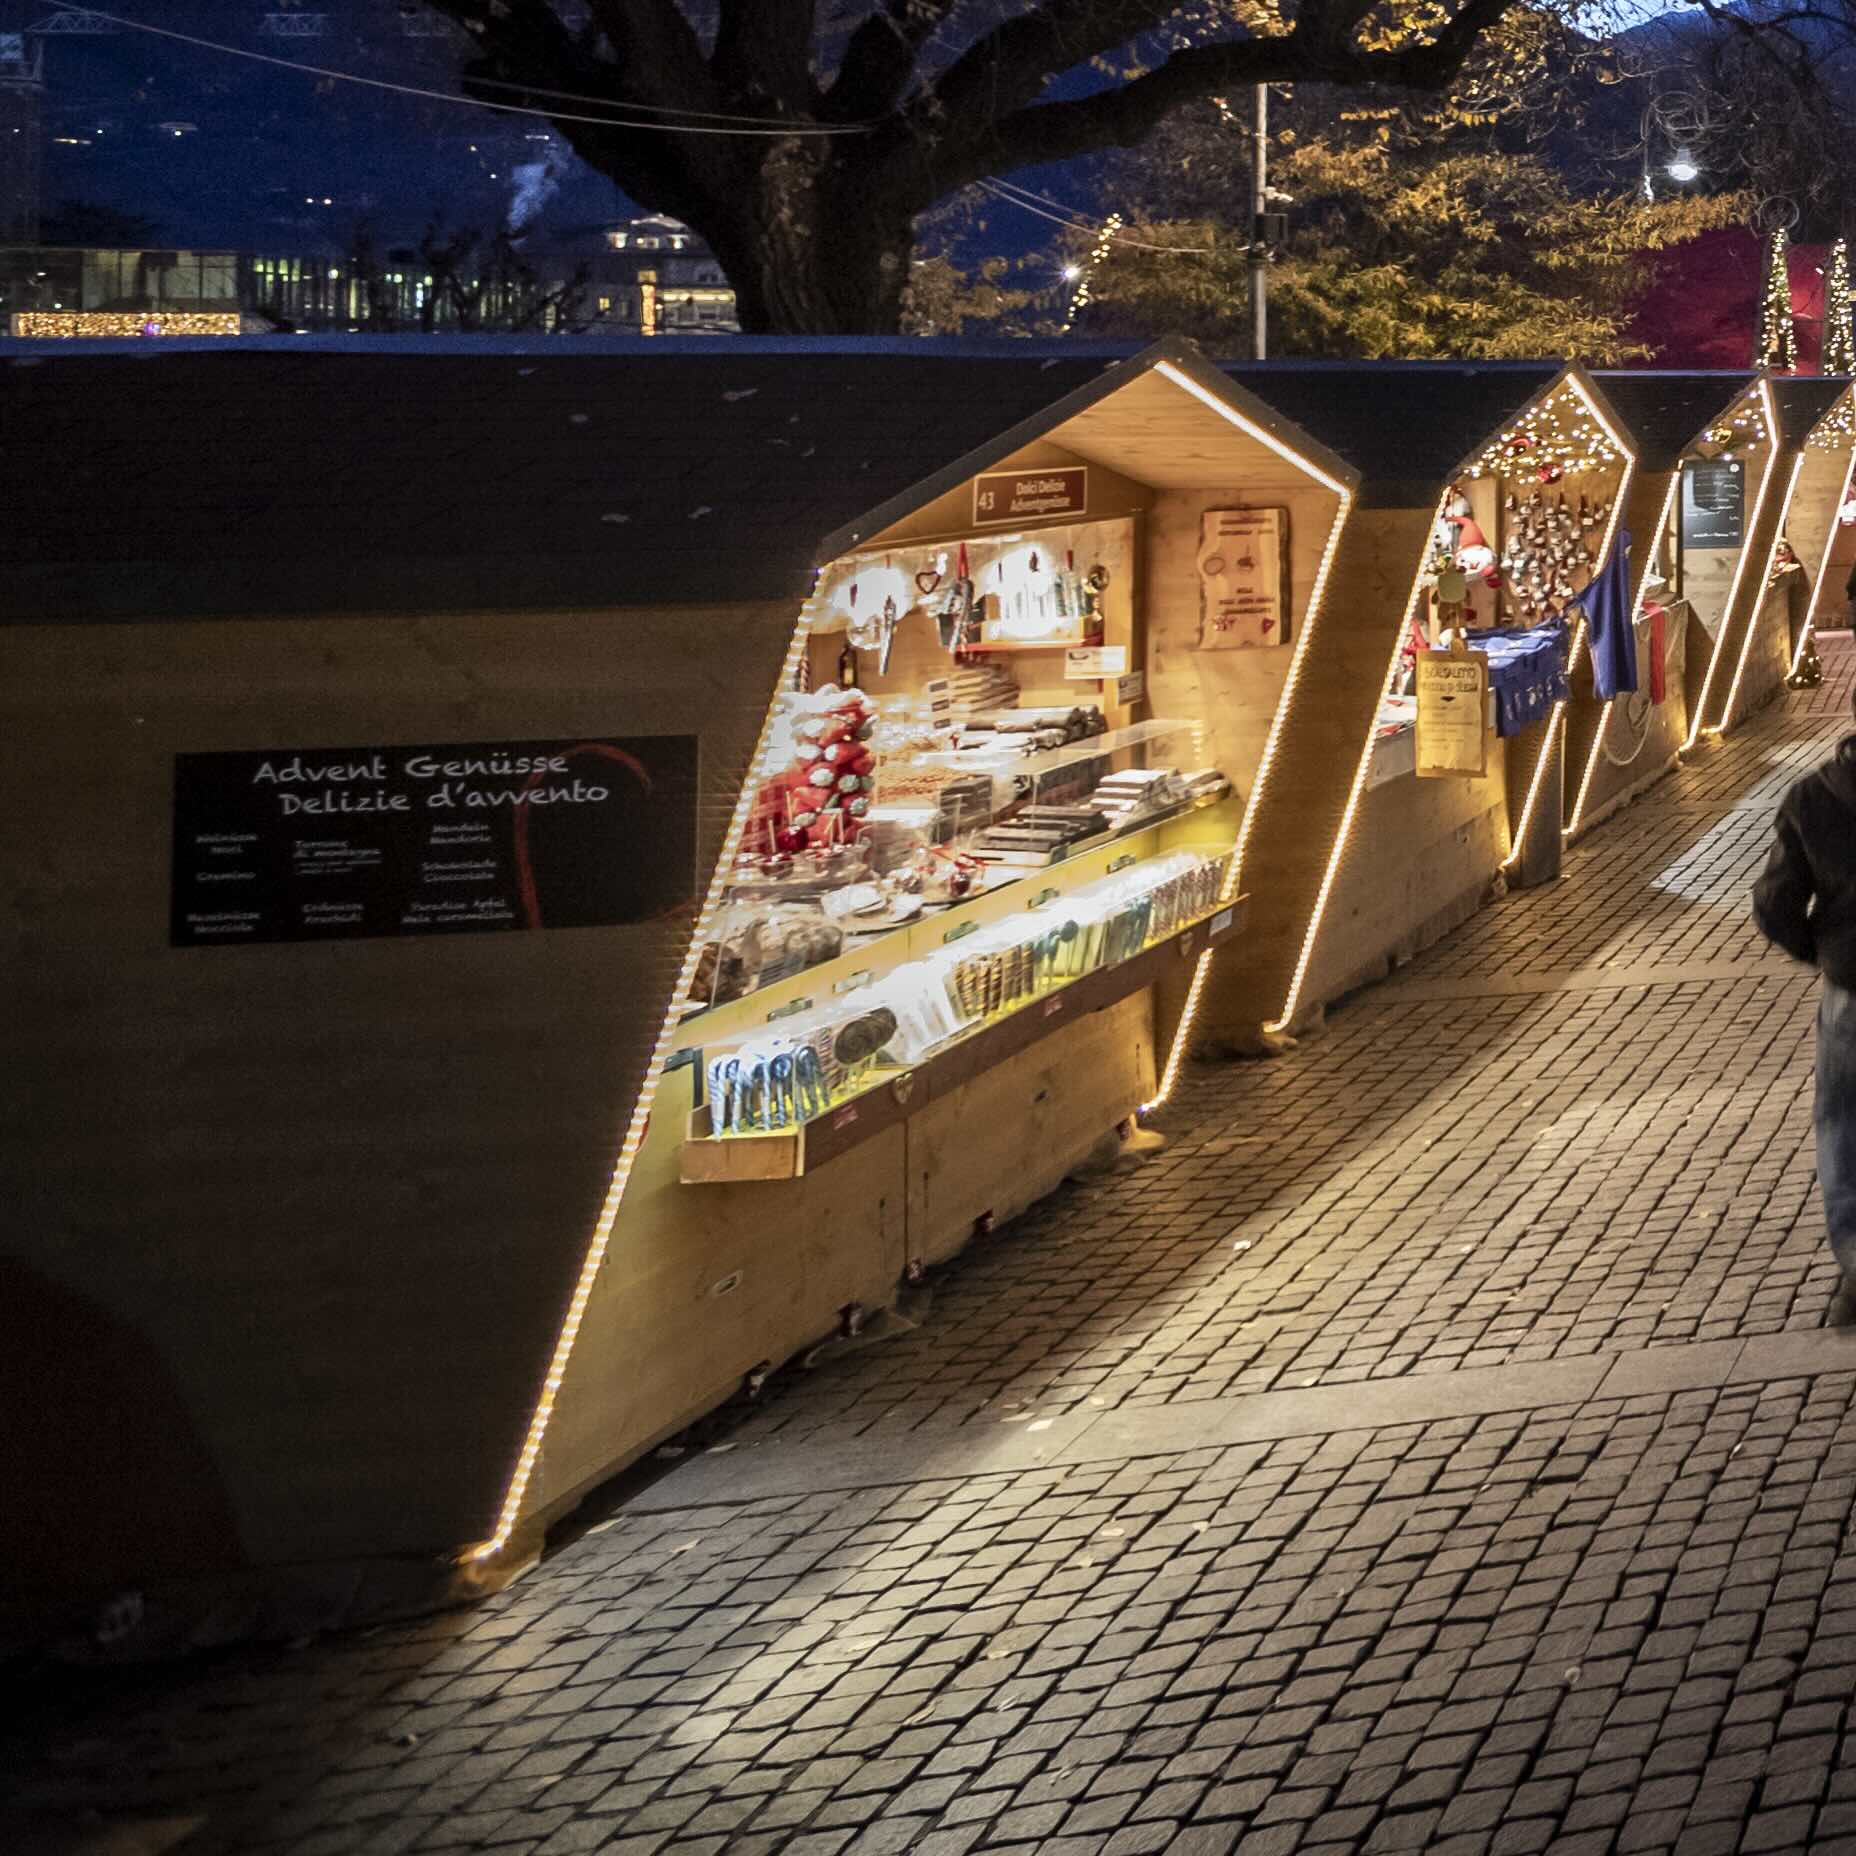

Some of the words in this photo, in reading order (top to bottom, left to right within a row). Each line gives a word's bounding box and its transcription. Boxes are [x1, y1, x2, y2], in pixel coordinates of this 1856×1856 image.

[979, 492, 996, 511] 43
[253, 754, 387, 786] Advent
[404, 752, 569, 779] Genüsse
[278, 790, 411, 817] Delizie
